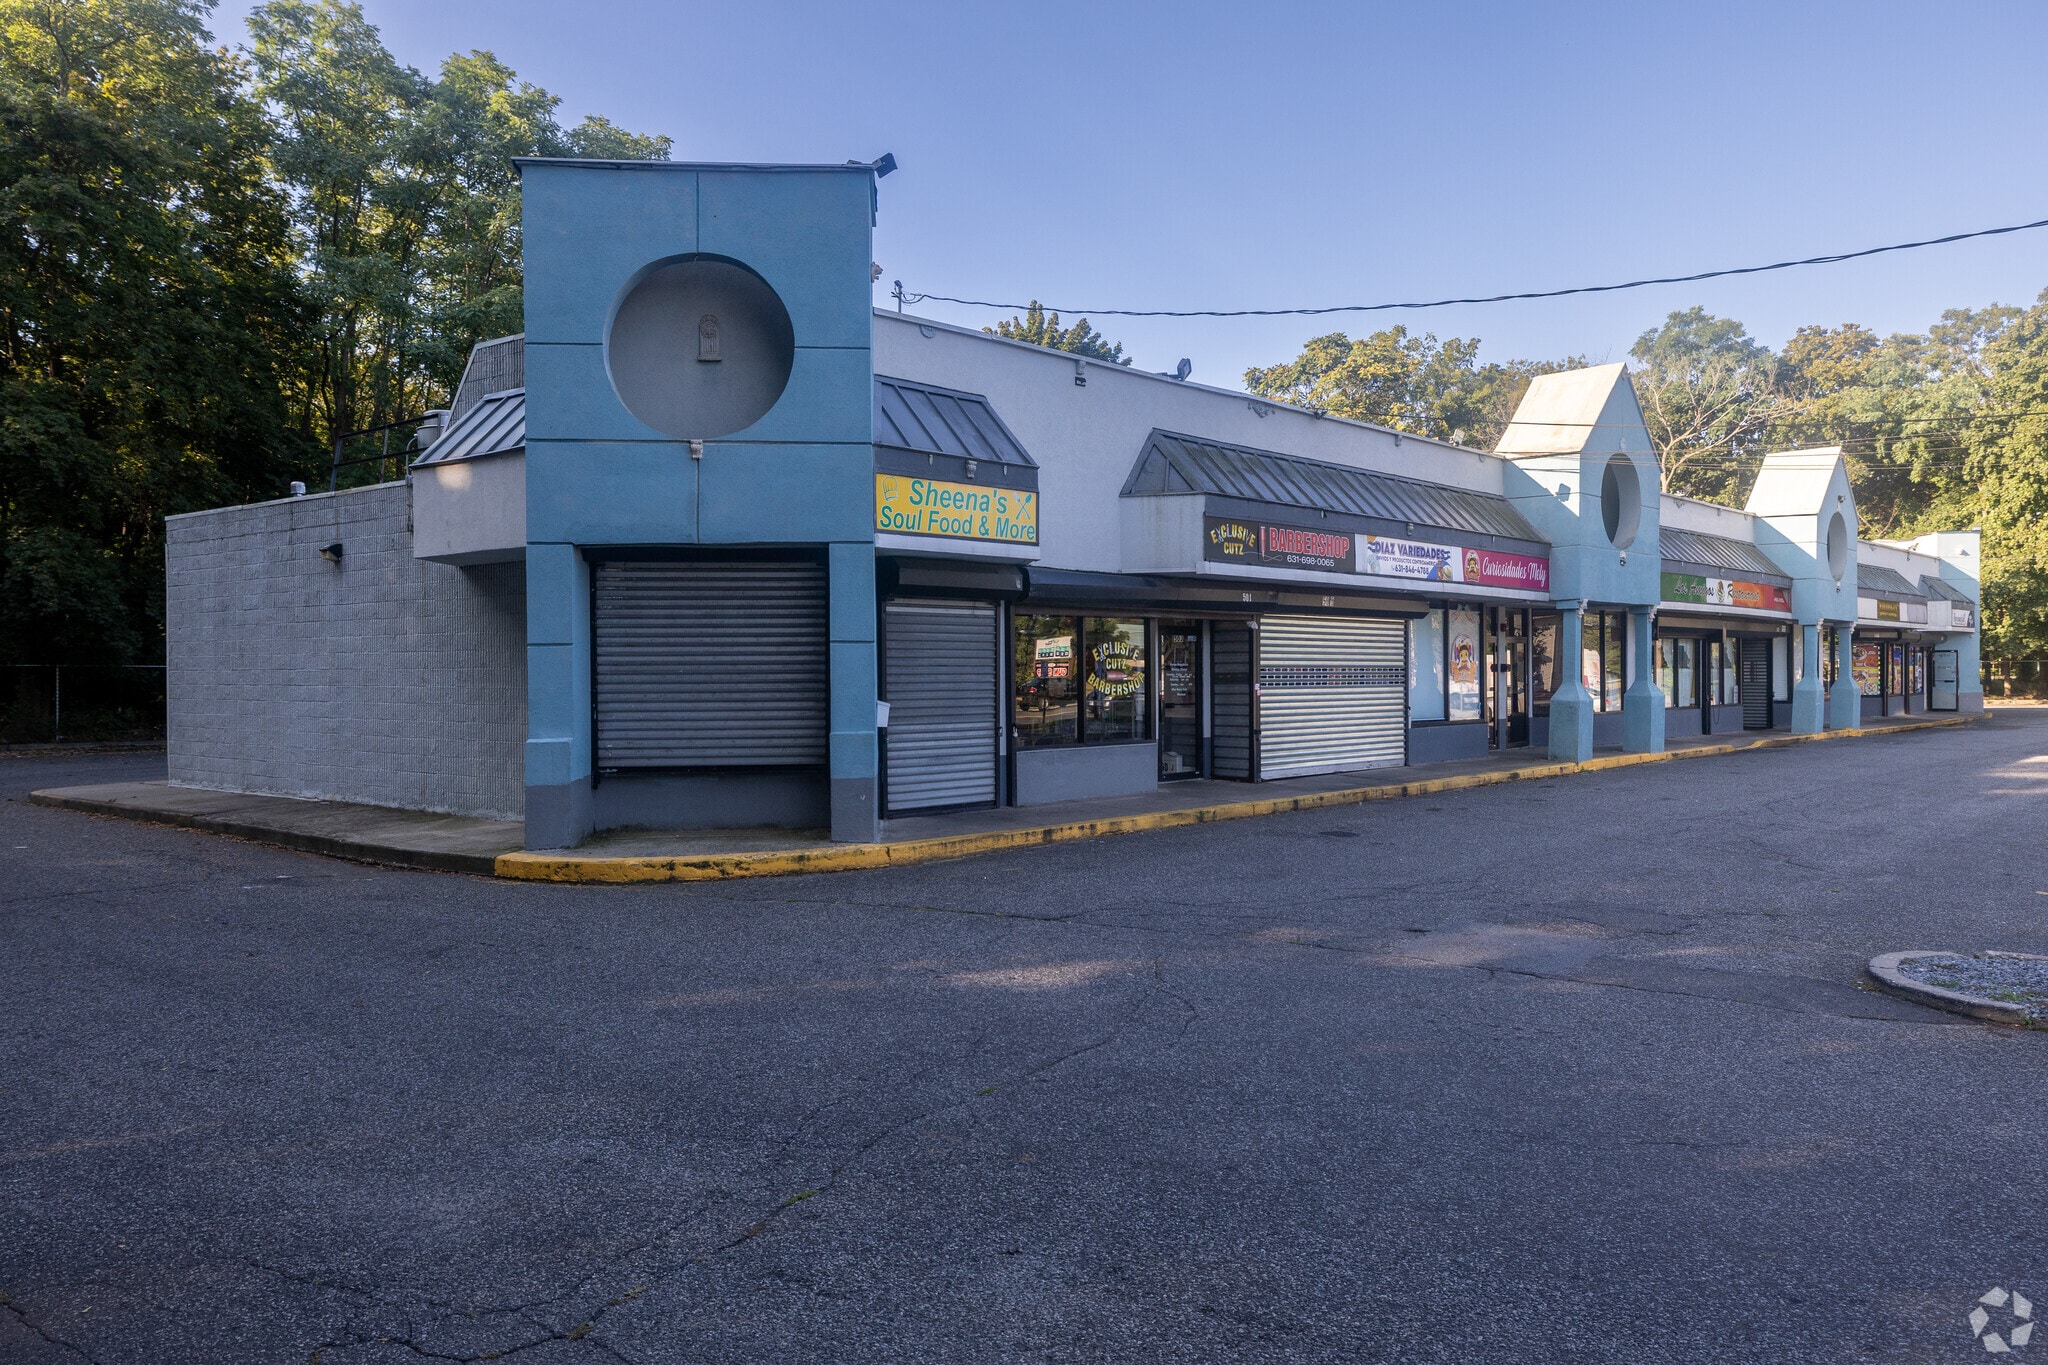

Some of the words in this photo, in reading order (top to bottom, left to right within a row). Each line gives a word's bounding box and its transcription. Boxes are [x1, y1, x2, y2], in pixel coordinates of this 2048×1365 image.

[909, 479, 1008, 515] Sheena's
[879, 505, 923, 530] Soul
[927, 510, 973, 535] Food
[978, 515, 990, 537] &
[995, 516, 1035, 541] More
[1223, 541, 1244, 556] CUTZ
[1269, 527, 1350, 559] BARBERSHOP
[1375, 541, 1396, 555] DIAZ
[1397, 543, 1446, 560] VARIEDADES
[1287, 554, 1335, 567] 631-698-0065
[1482, 556, 1527, 580] Curiosidades
[1106, 658, 1127, 670] CUTZ
[1087, 672, 1145, 697] BARBERSHOP
